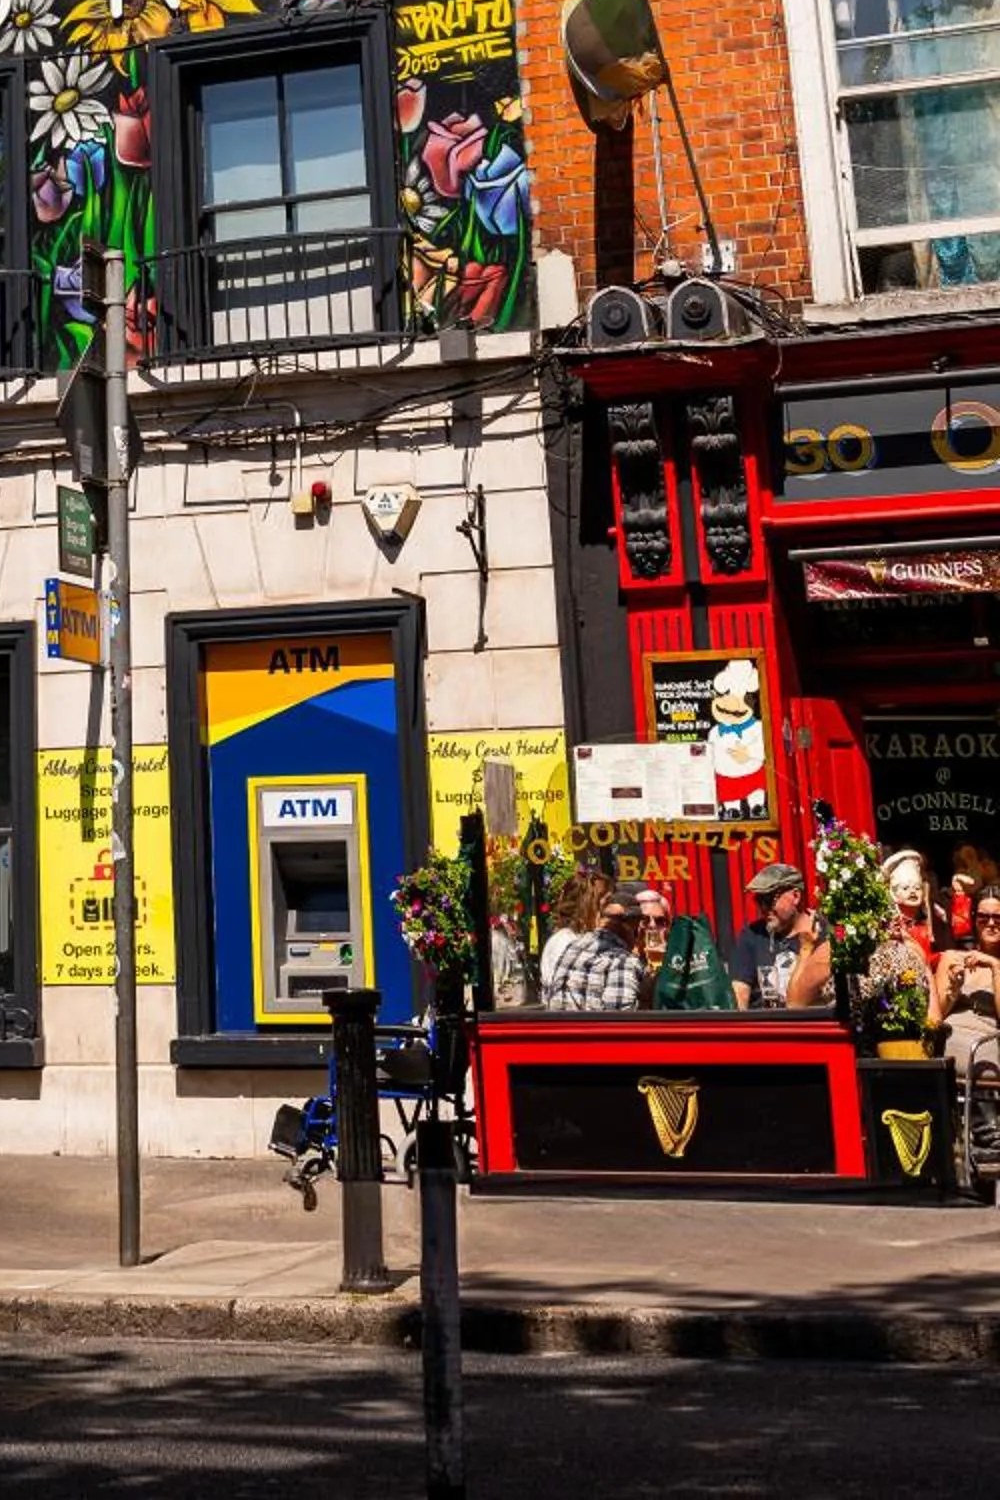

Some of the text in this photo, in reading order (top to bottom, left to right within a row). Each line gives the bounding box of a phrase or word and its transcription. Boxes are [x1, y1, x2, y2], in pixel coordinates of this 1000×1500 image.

[47, 591, 59, 645] ATM
[62, 606, 97, 640] ATM
[267, 645, 341, 675] ATM
[432, 737, 560, 761] Abbey Court Hostel
[865, 732, 1000, 759] KARAOK
[278, 798, 338, 818] ATM
[435, 789, 483, 806] Lugga
[45, 805, 108, 822] Luggage
[928, 814, 970, 832] BAR
[617, 854, 693, 882] BAR
[62, 942, 102, 958] Open
[55, 963, 65, 977] 7
[68, 963, 103, 982] days
